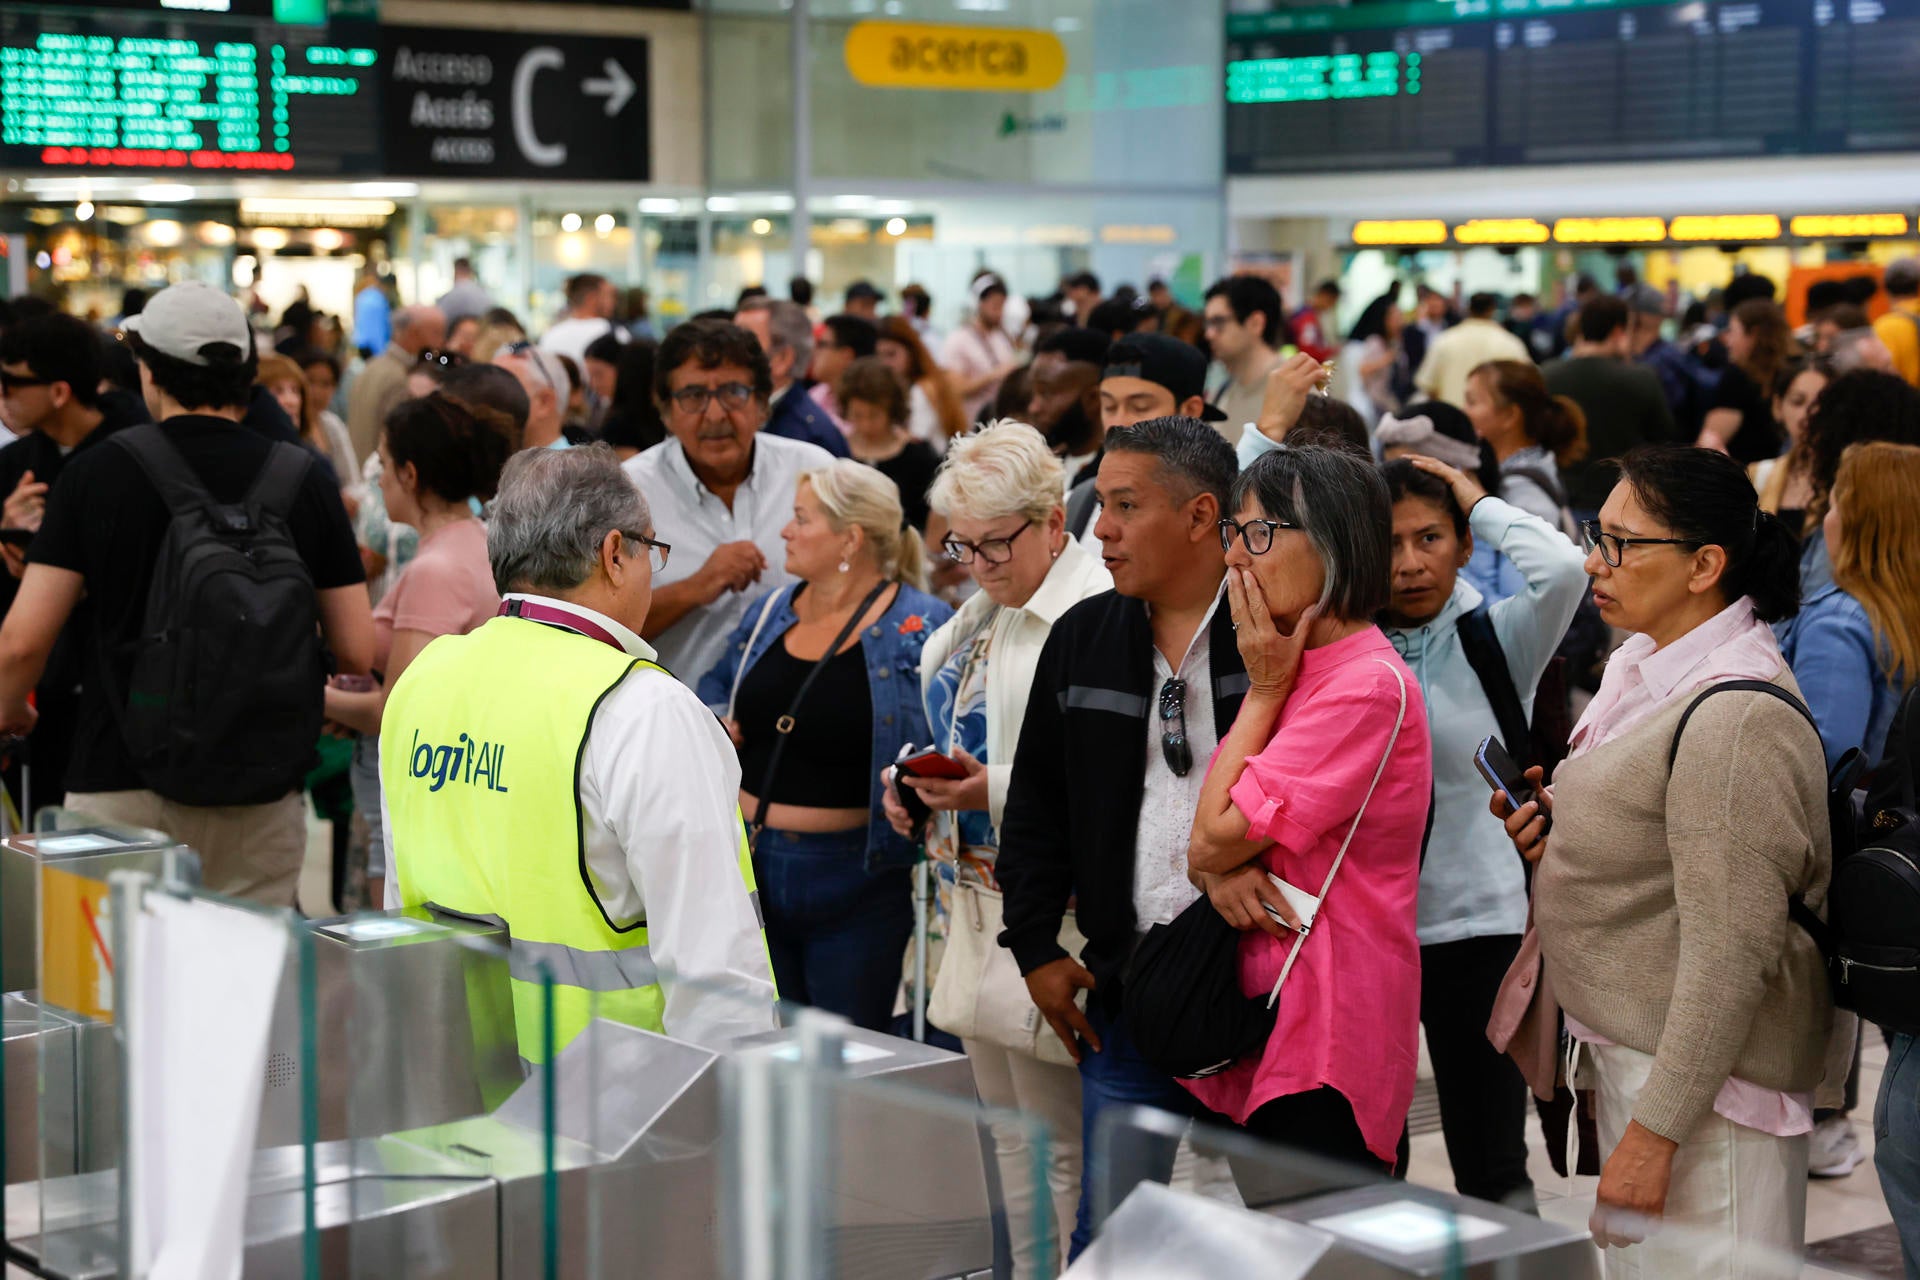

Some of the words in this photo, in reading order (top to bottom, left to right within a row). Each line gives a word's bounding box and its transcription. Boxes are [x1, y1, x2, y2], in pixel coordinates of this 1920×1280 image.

[393, 46, 493, 84] Acceso
[889, 37, 1028, 77] acerca
[411, 91, 494, 128] Accés
[511, 47, 567, 167] C
